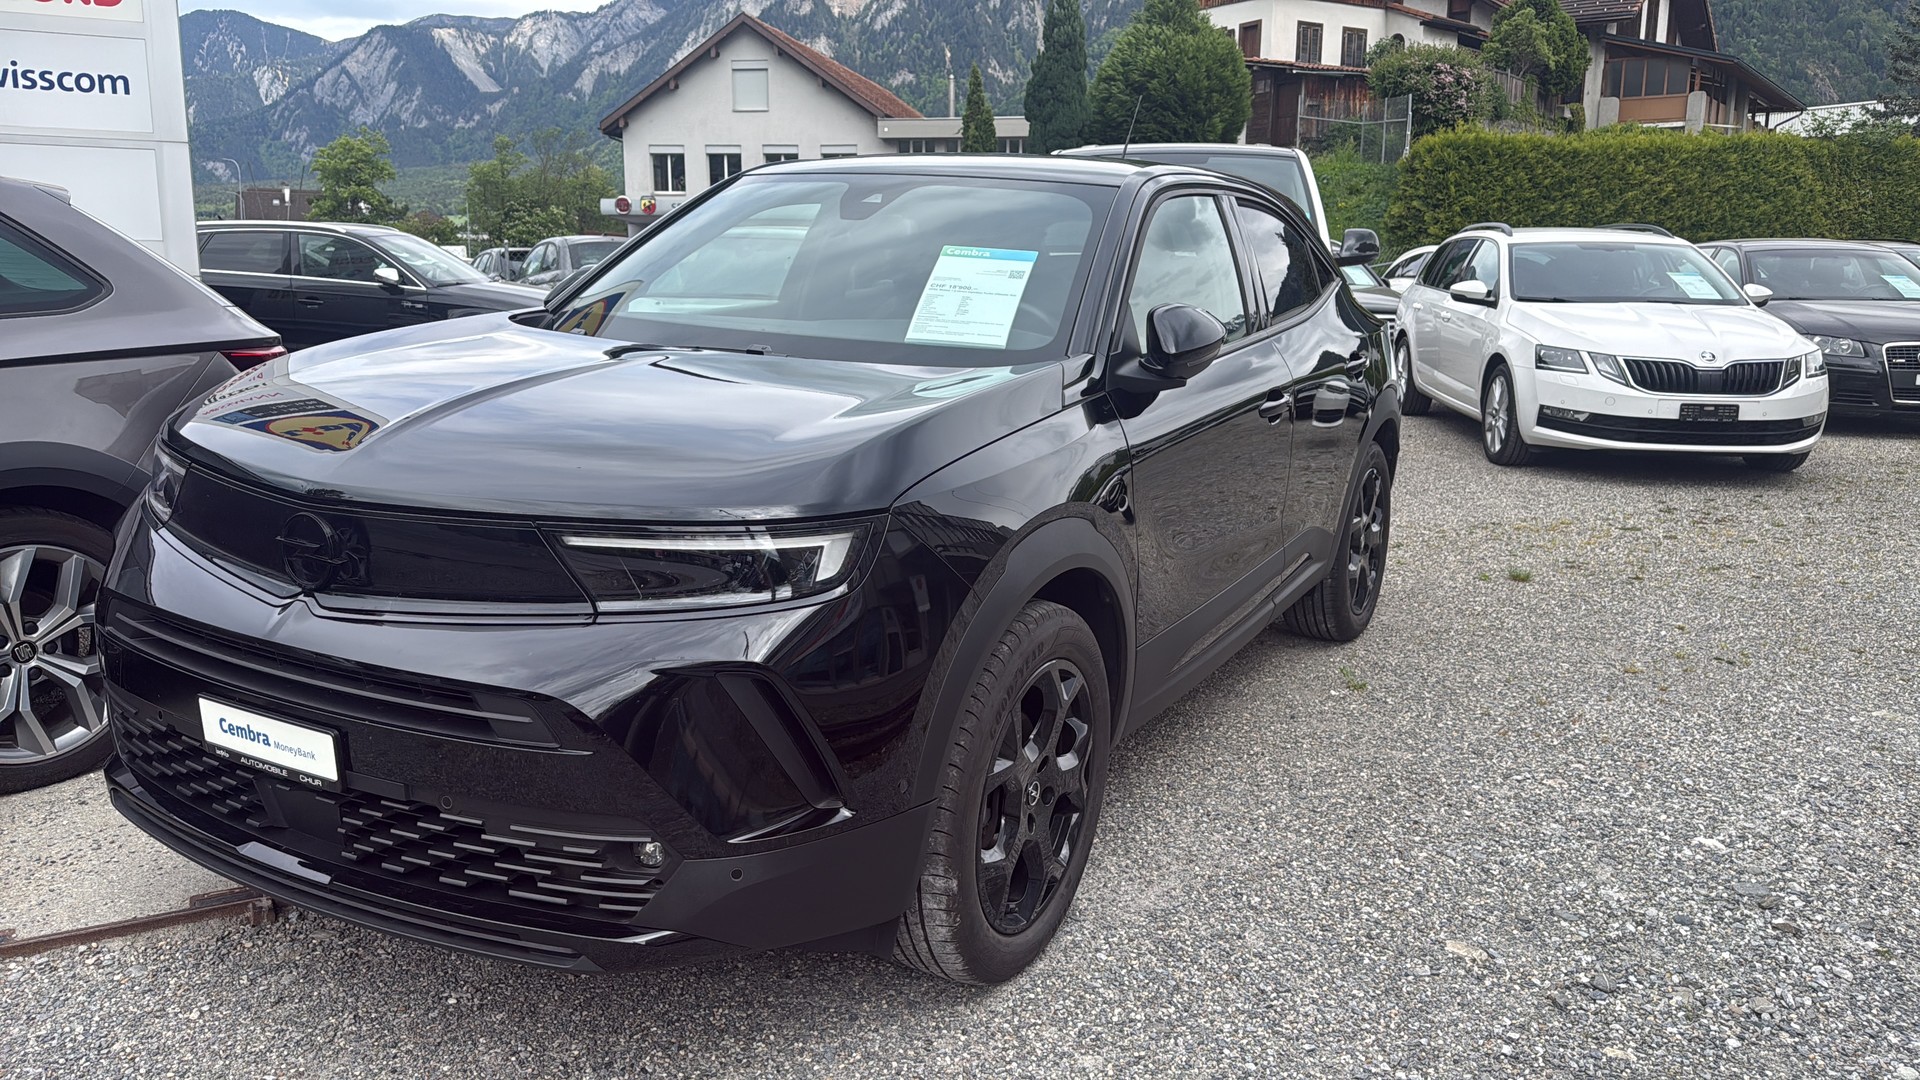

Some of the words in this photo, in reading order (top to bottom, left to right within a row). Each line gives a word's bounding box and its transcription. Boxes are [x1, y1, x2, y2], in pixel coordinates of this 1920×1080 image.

[219, 717, 271, 747] Cembra
[273, 740, 317, 761] MoneyBank
[240, 756, 289, 777] AUTOMOBILE
[299, 774, 322, 787] CHUR
